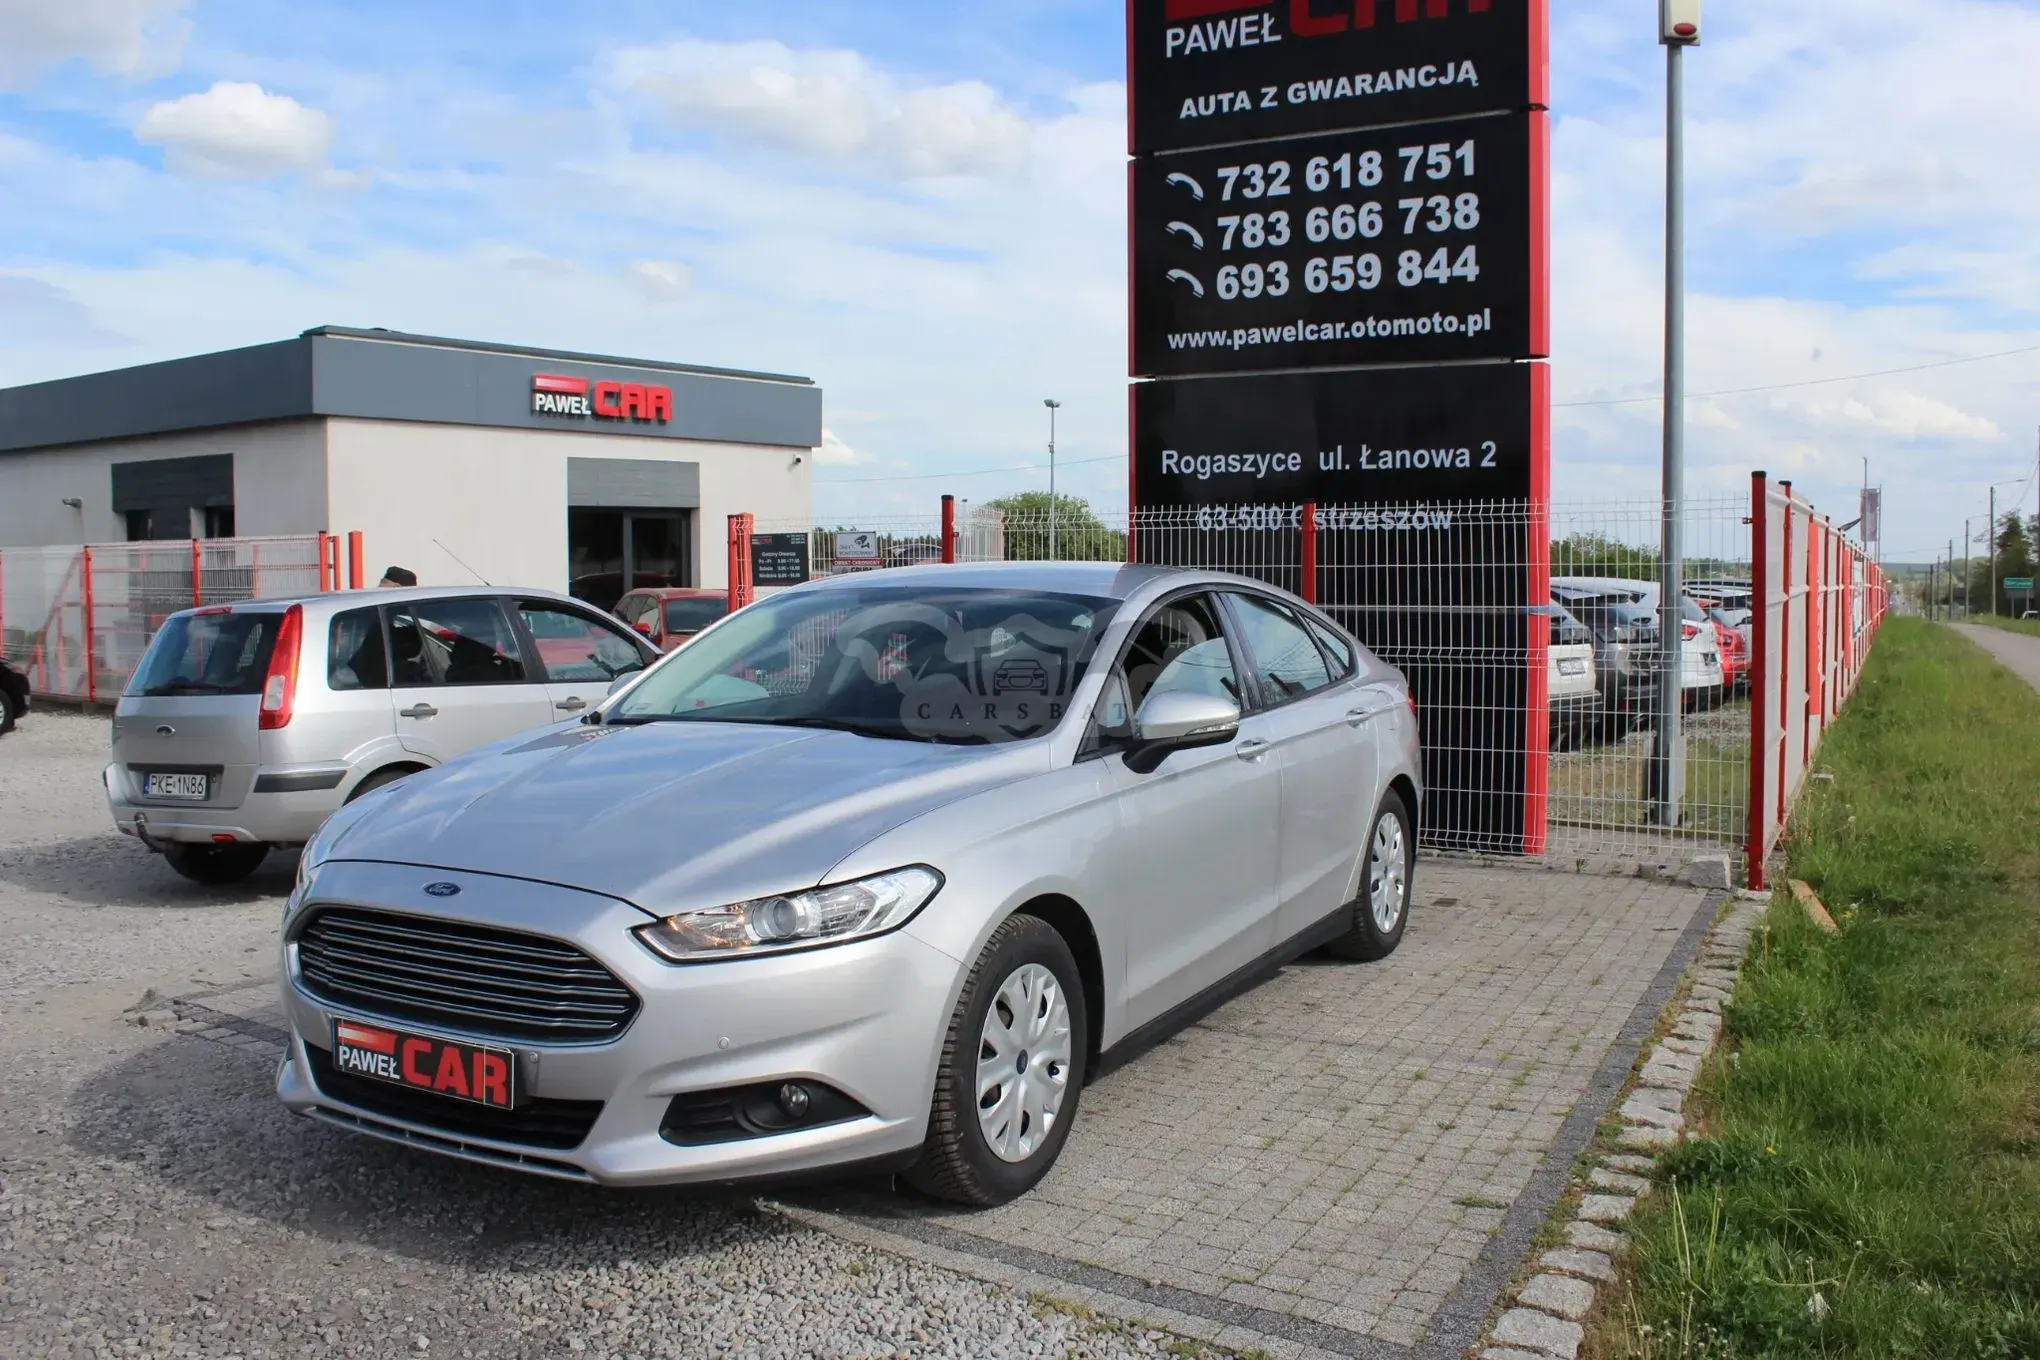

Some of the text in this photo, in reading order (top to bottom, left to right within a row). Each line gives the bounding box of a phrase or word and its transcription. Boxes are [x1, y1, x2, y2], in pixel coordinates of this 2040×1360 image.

[1166, 13, 1282, 58] PAWEŁ
[1179, 60, 1480, 119] AUTA Z GWARANCJĄ
[1217, 140, 1475, 201] 732 618 751
[1217, 193, 1480, 251] 783 666 738
[1216, 245, 1480, 300] 693 659 844
[1167, 308, 1491, 351] www.pawelcar.otomoto.pl
[535, 381, 672, 421] PAWEŁ CAR
[1161, 441, 1497, 480] Rogaszyce ul. Łanowa 2
[1199, 506, 1282, 531] 63-500
[339, 1037, 509, 1104] PAWEŁ CAR
